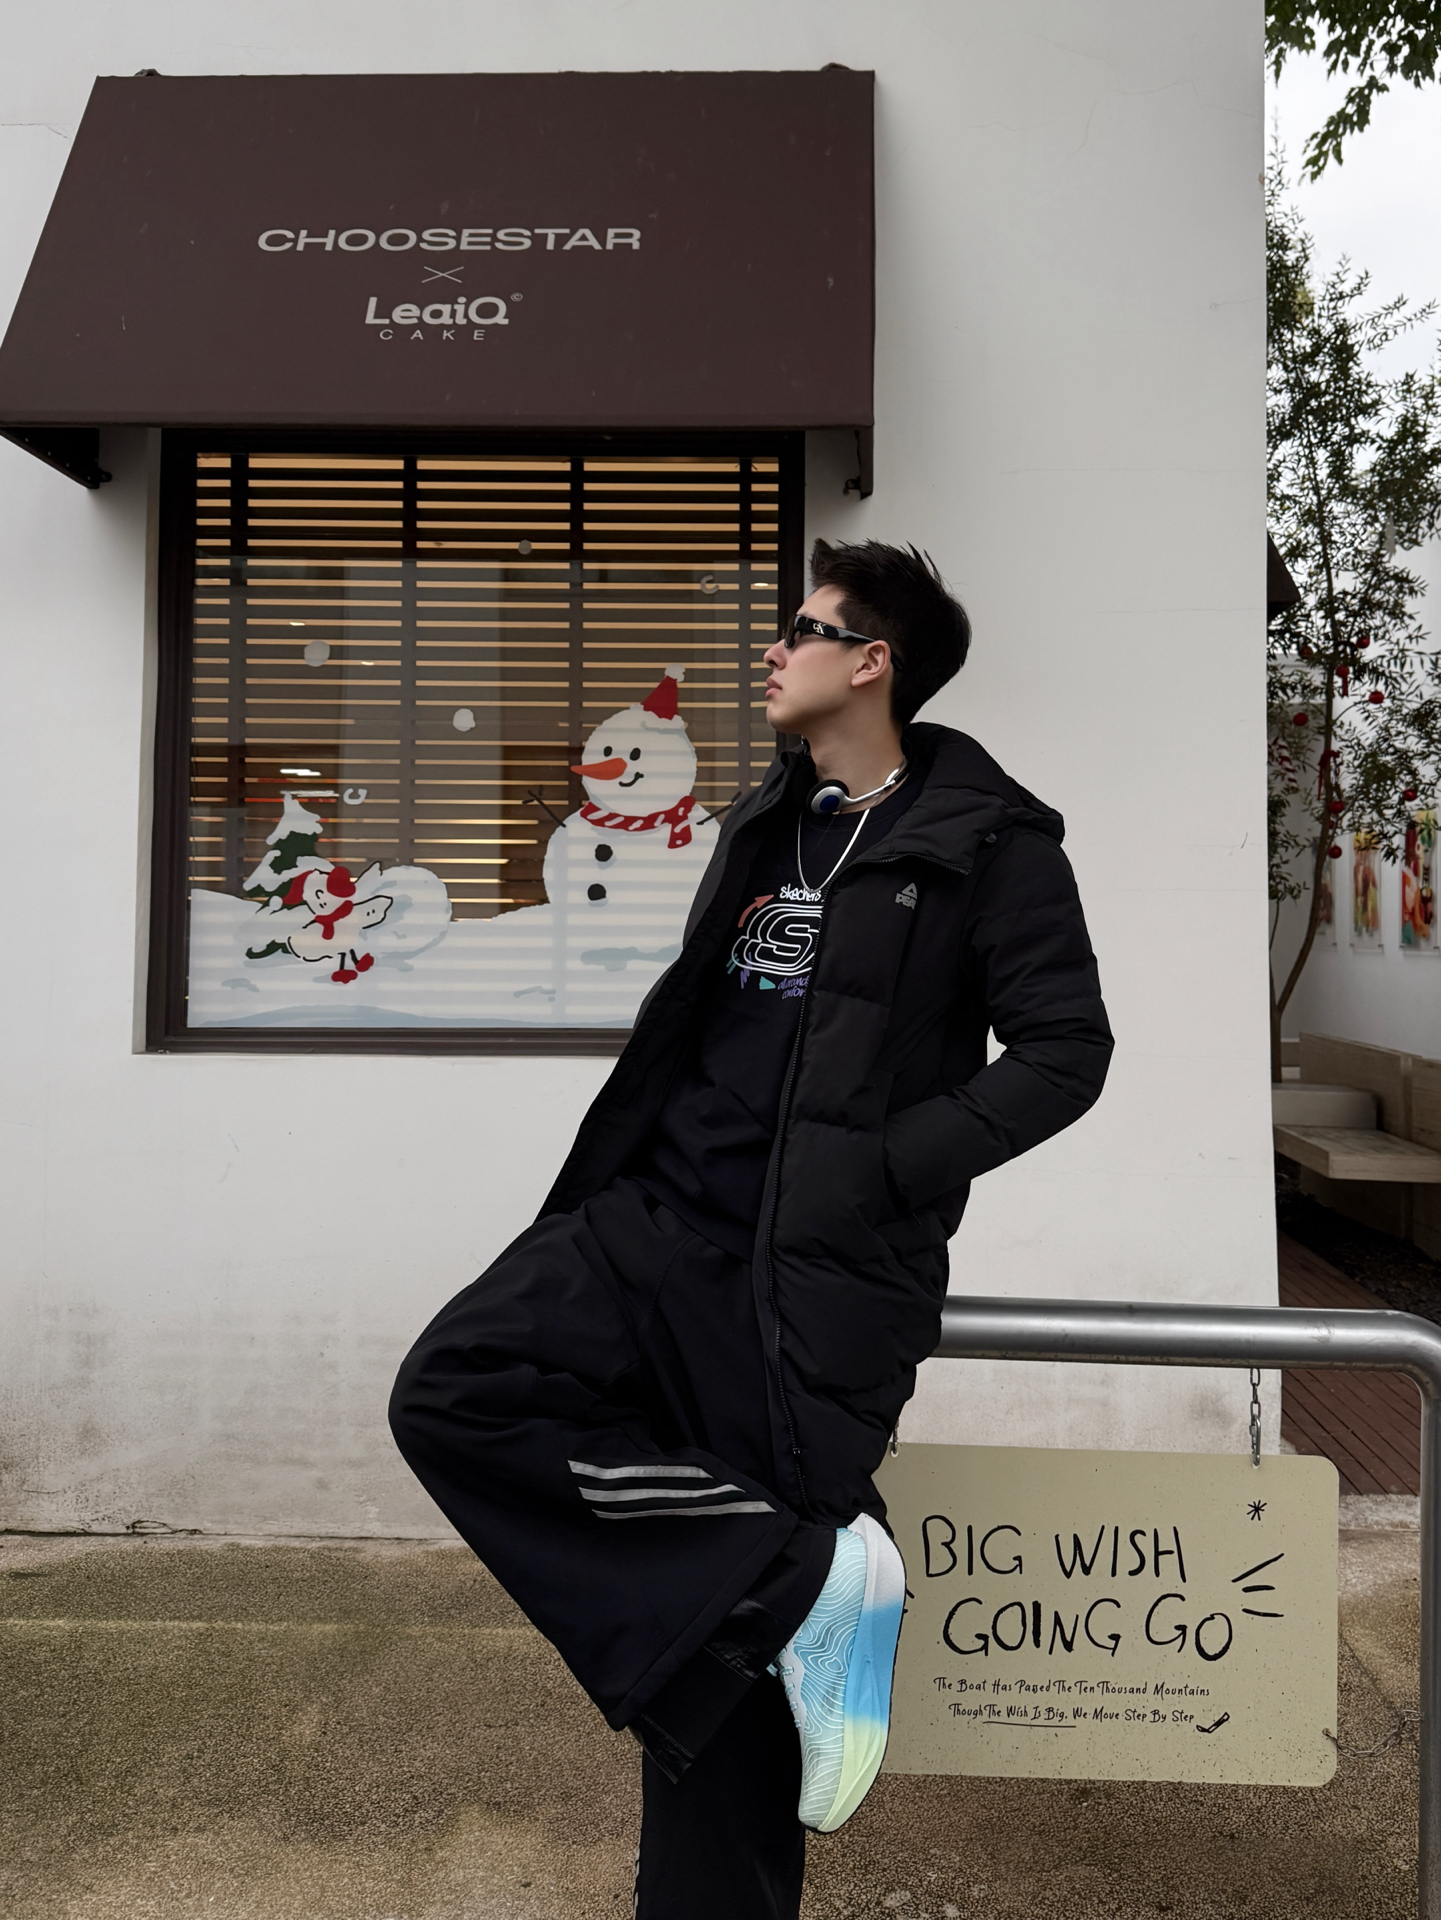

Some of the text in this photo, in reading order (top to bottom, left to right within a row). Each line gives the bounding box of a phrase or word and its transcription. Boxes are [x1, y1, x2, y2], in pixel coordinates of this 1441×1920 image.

[257, 227, 641, 252] CHOOSESTAR
[379, 328, 486, 341] CAKE
[922, 1515, 1187, 1584] BIG WISH
[942, 1597, 1122, 1658] GOING
[933, 1676, 953, 1692] The
[956, 1678, 988, 1693] Boat
[991, 1677, 1012, 1695] Has
[1052, 1679, 1073, 1695] The
[1073, 1680, 1095, 1695] Ten
[1096, 1680, 1148, 1696] Thousand
[1153, 1681, 1211, 1701] Mountains
[948, 1702, 984, 1720] Though
[983, 1703, 1002, 1719] The
[1006, 1705, 1029, 1719] Wish
[1030, 1705, 1042, 1721] Is
[1072, 1706, 1088, 1720] We
[1092, 1705, 1120, 1723] Move
[1124, 1708, 1148, 1722] Step
[1149, 1709, 1167, 1723] By
[1171, 1709, 1195, 1723] Step
